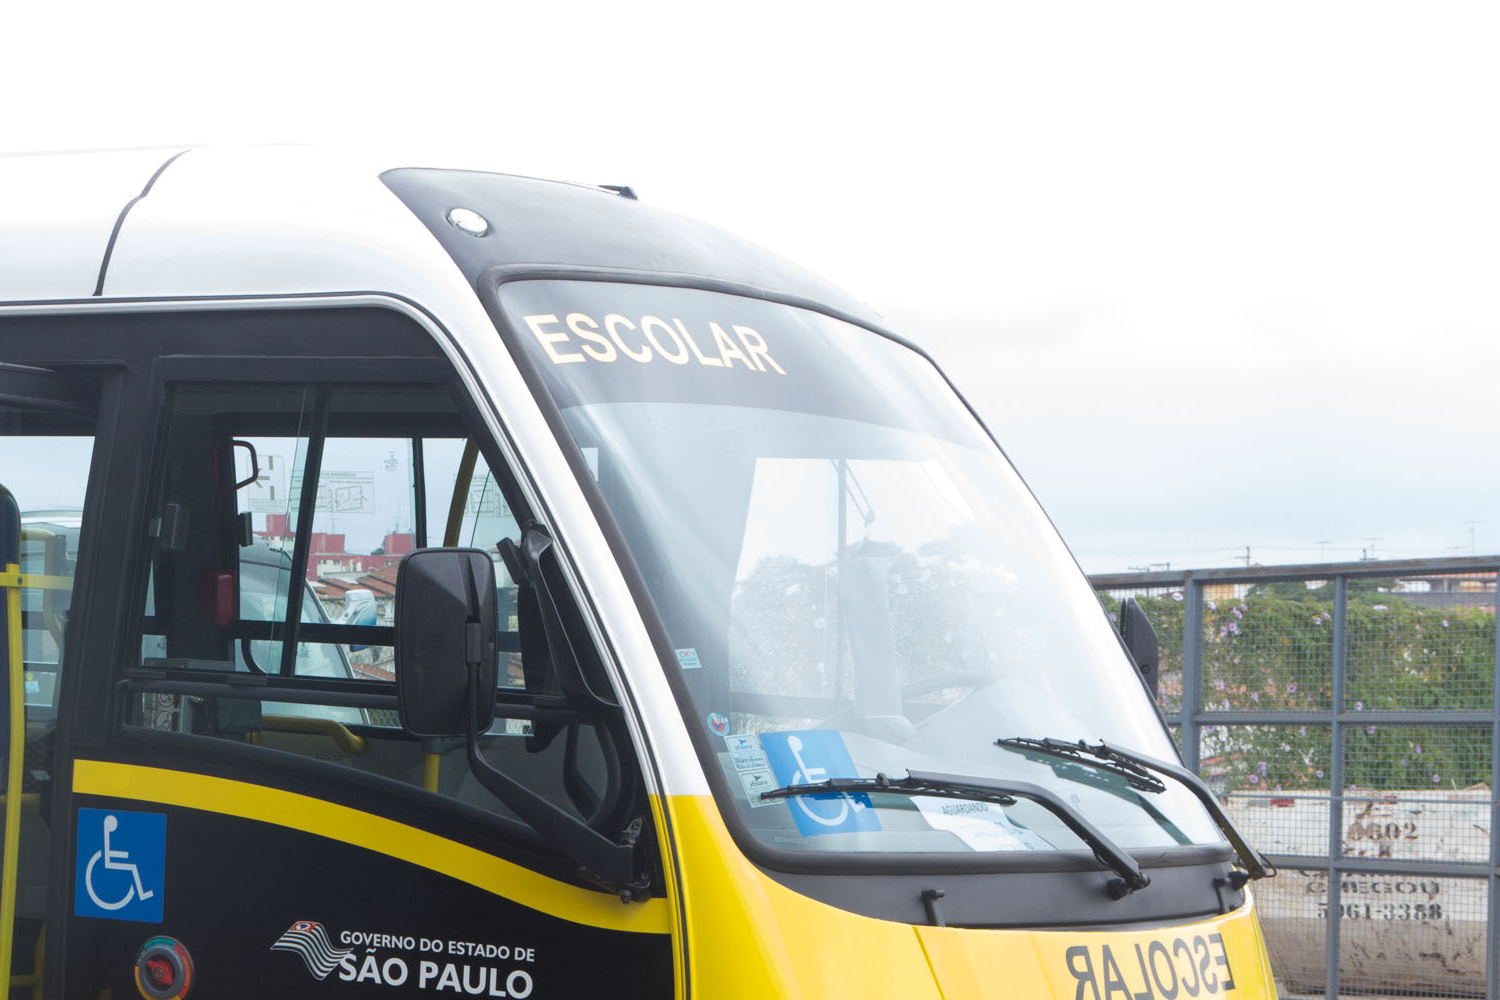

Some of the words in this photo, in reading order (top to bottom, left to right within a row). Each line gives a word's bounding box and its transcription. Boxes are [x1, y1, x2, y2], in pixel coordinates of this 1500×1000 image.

[523, 312, 788, 376] ESCOLAR
[941, 802, 989, 816] AGUARDANDO
[1316, 903, 1443, 921] 561-3388
[340, 930, 416, 950] GOVERNO
[419, 938, 444, 954] DO
[447, 941, 511, 960] ESTADO
[514, 947, 536, 963] DE
[338, 947, 409, 987] SÃO
[418, 960, 534, 1000] PAULO
